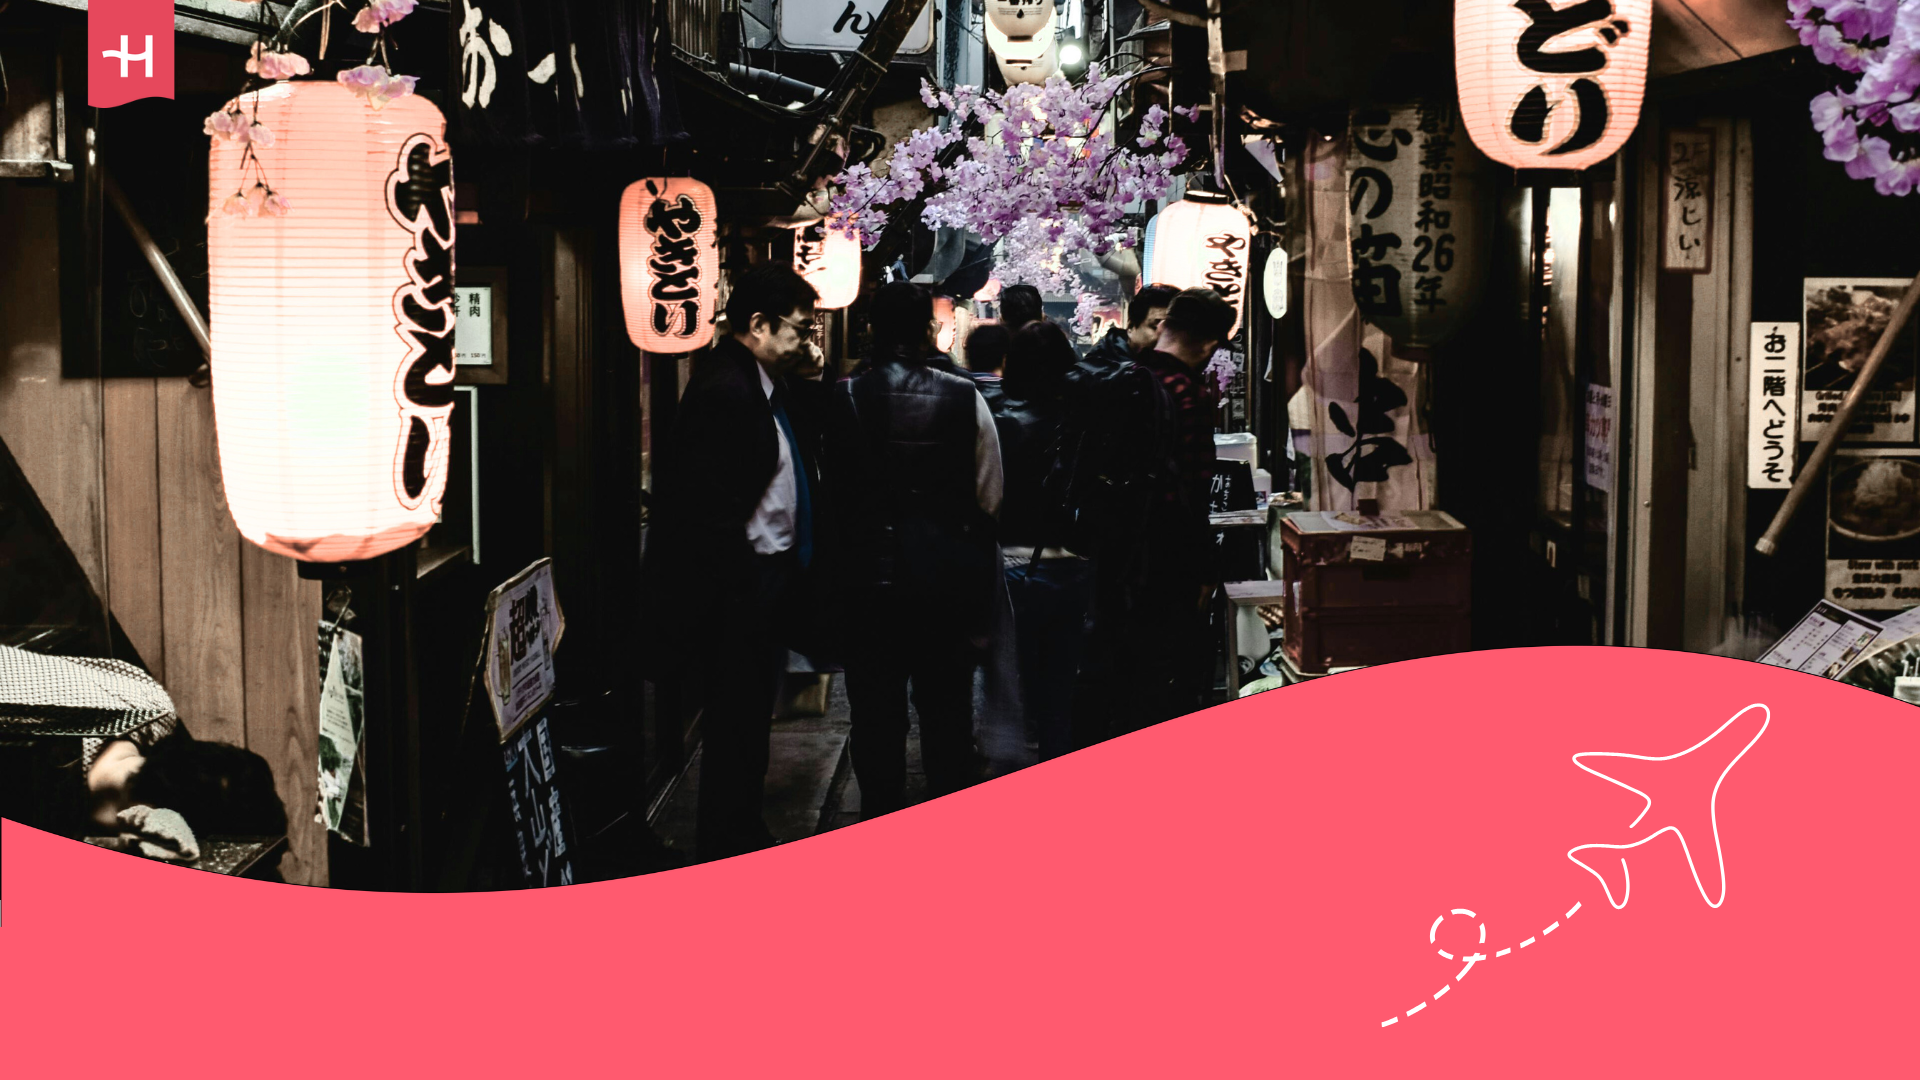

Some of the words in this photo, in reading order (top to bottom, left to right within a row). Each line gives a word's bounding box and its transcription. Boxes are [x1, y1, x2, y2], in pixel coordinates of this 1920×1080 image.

[643, 195, 702, 339] やきとり
[1412, 100, 1454, 313] 創業昭和26年
[469, 292, 480, 317] 精肉
